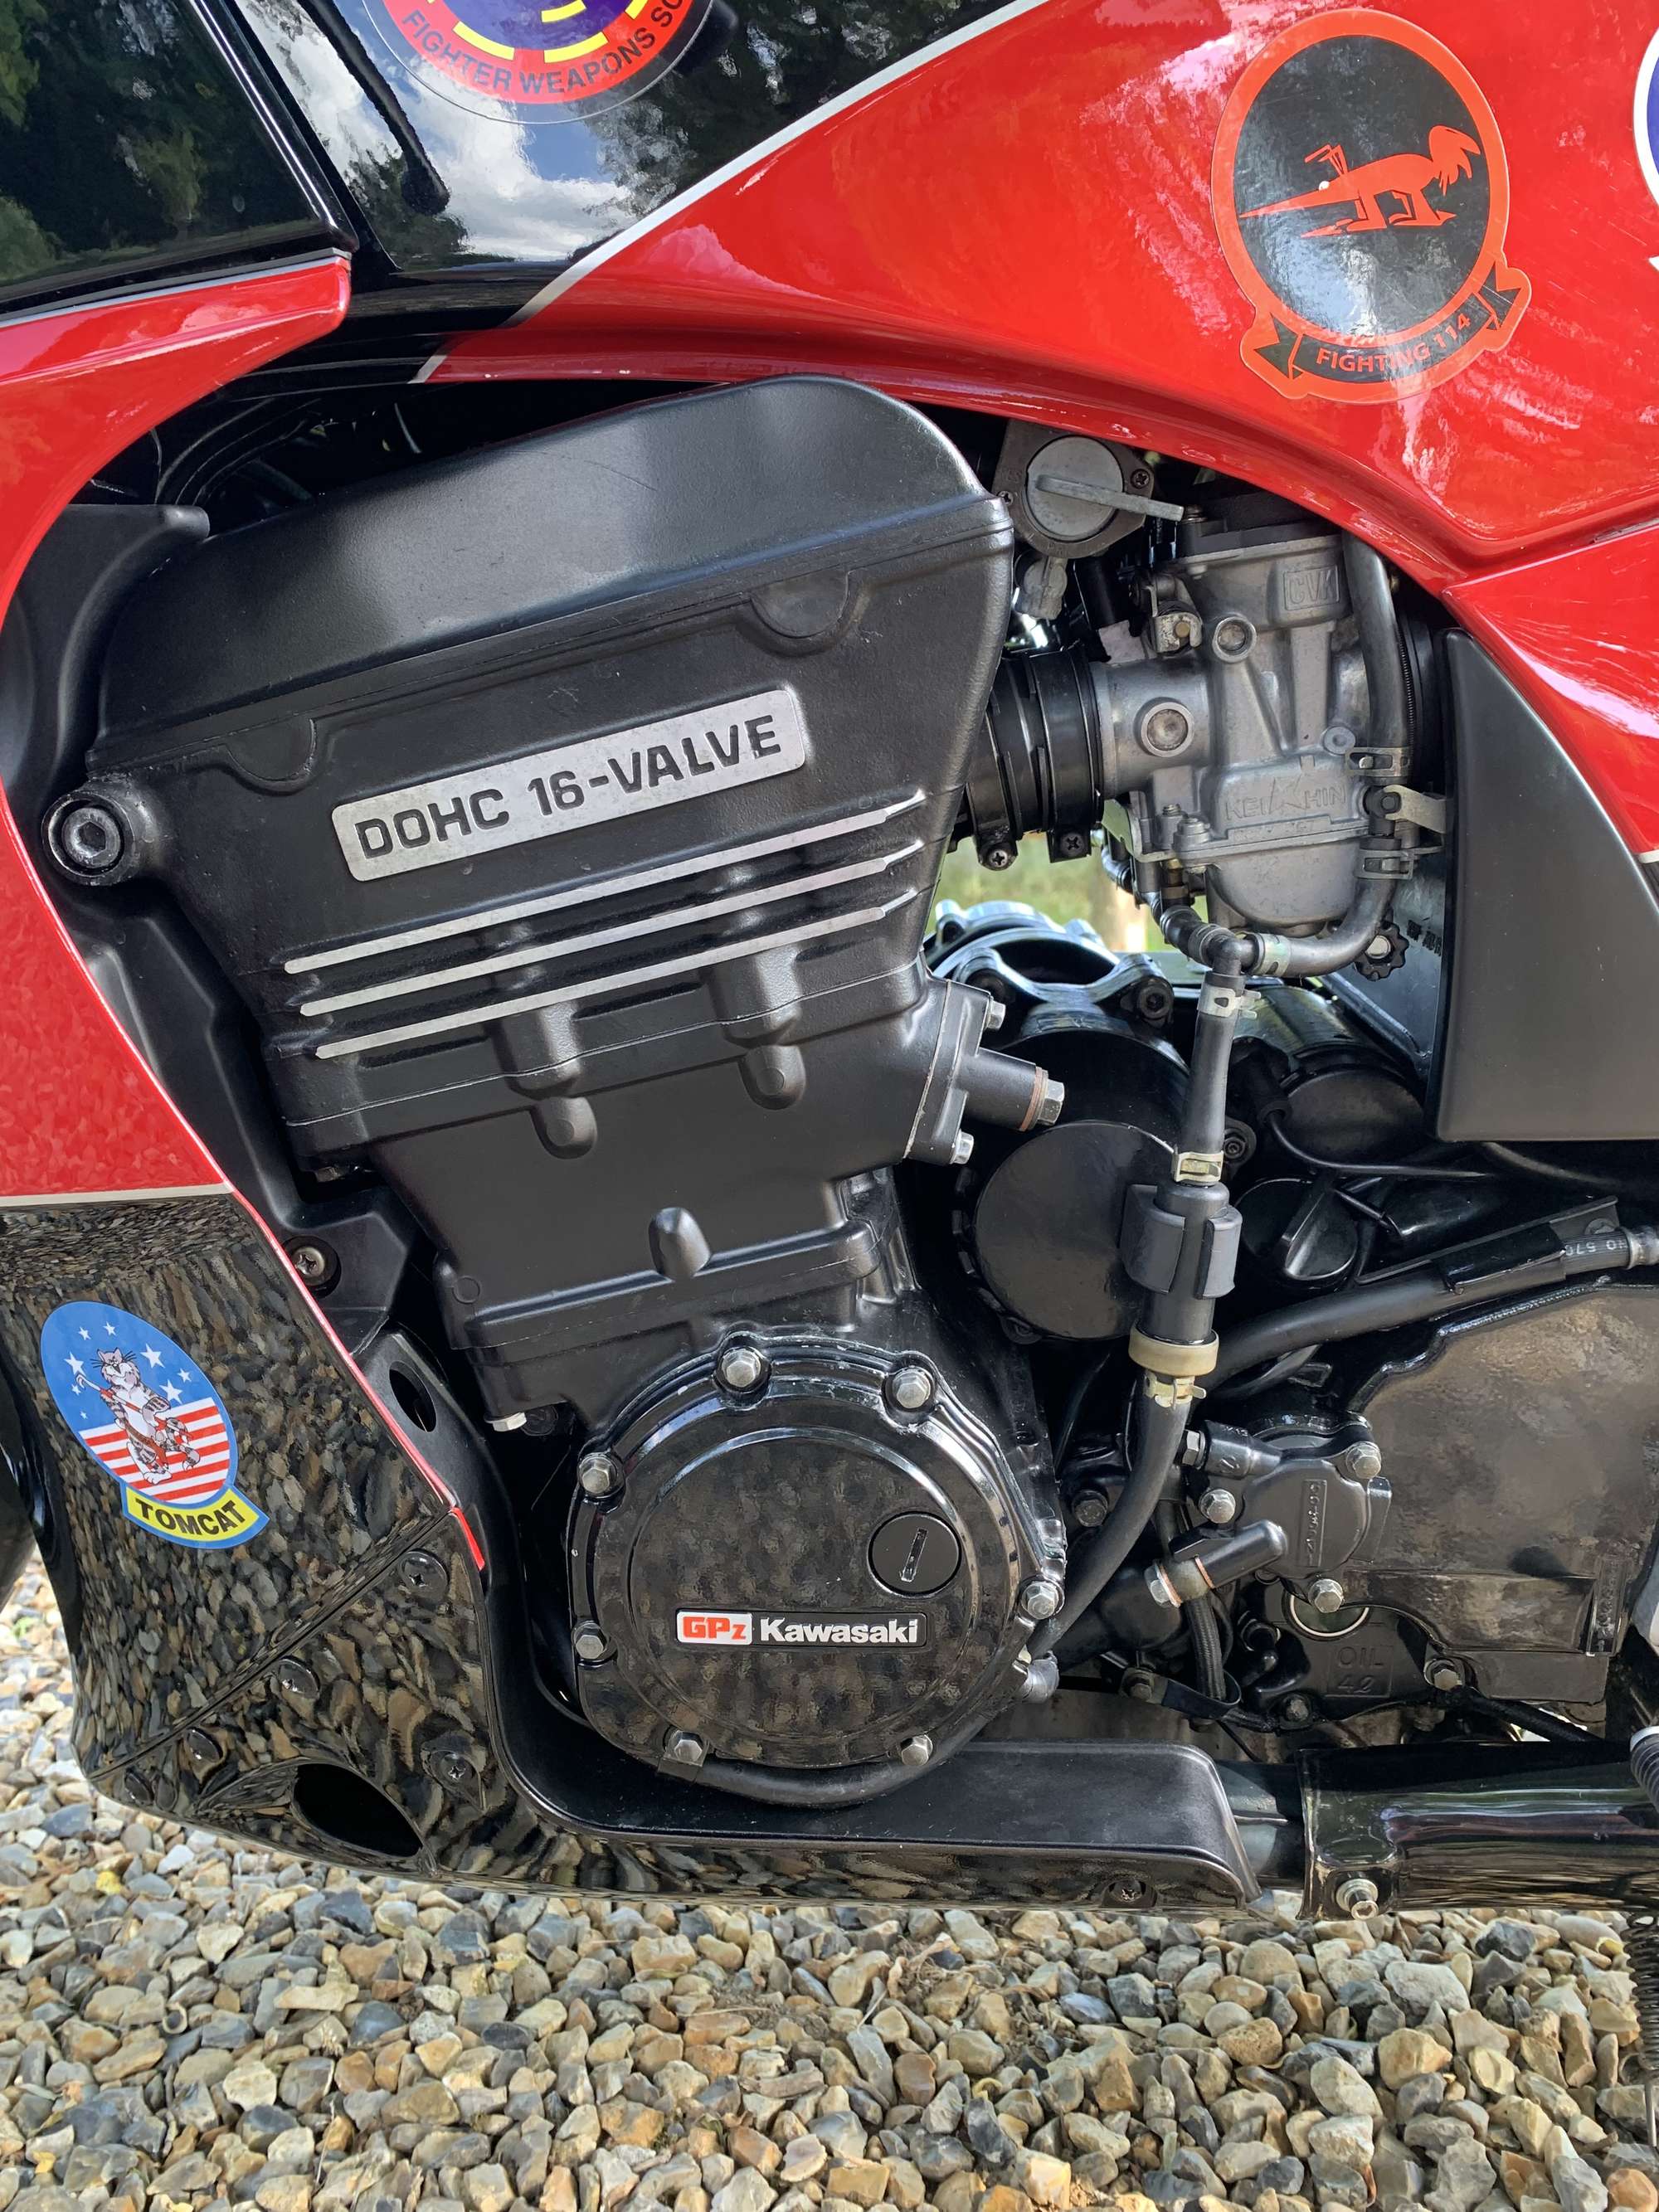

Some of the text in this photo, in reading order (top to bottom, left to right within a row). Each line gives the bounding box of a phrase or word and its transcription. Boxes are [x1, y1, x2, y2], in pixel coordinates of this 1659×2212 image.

[401, 10, 512, 94] FIGHTER
[519, 27, 656, 94] WEAPONS
[1316, 313, 1472, 372] FIGHTING 114
[354, 714, 781, 859] DOHC 16-VALVE
[134, 1497, 246, 1536] TOMCAT
[682, 1616, 919, 1644] GPz Kawasaki
[1338, 1646, 1384, 1668] OIL
